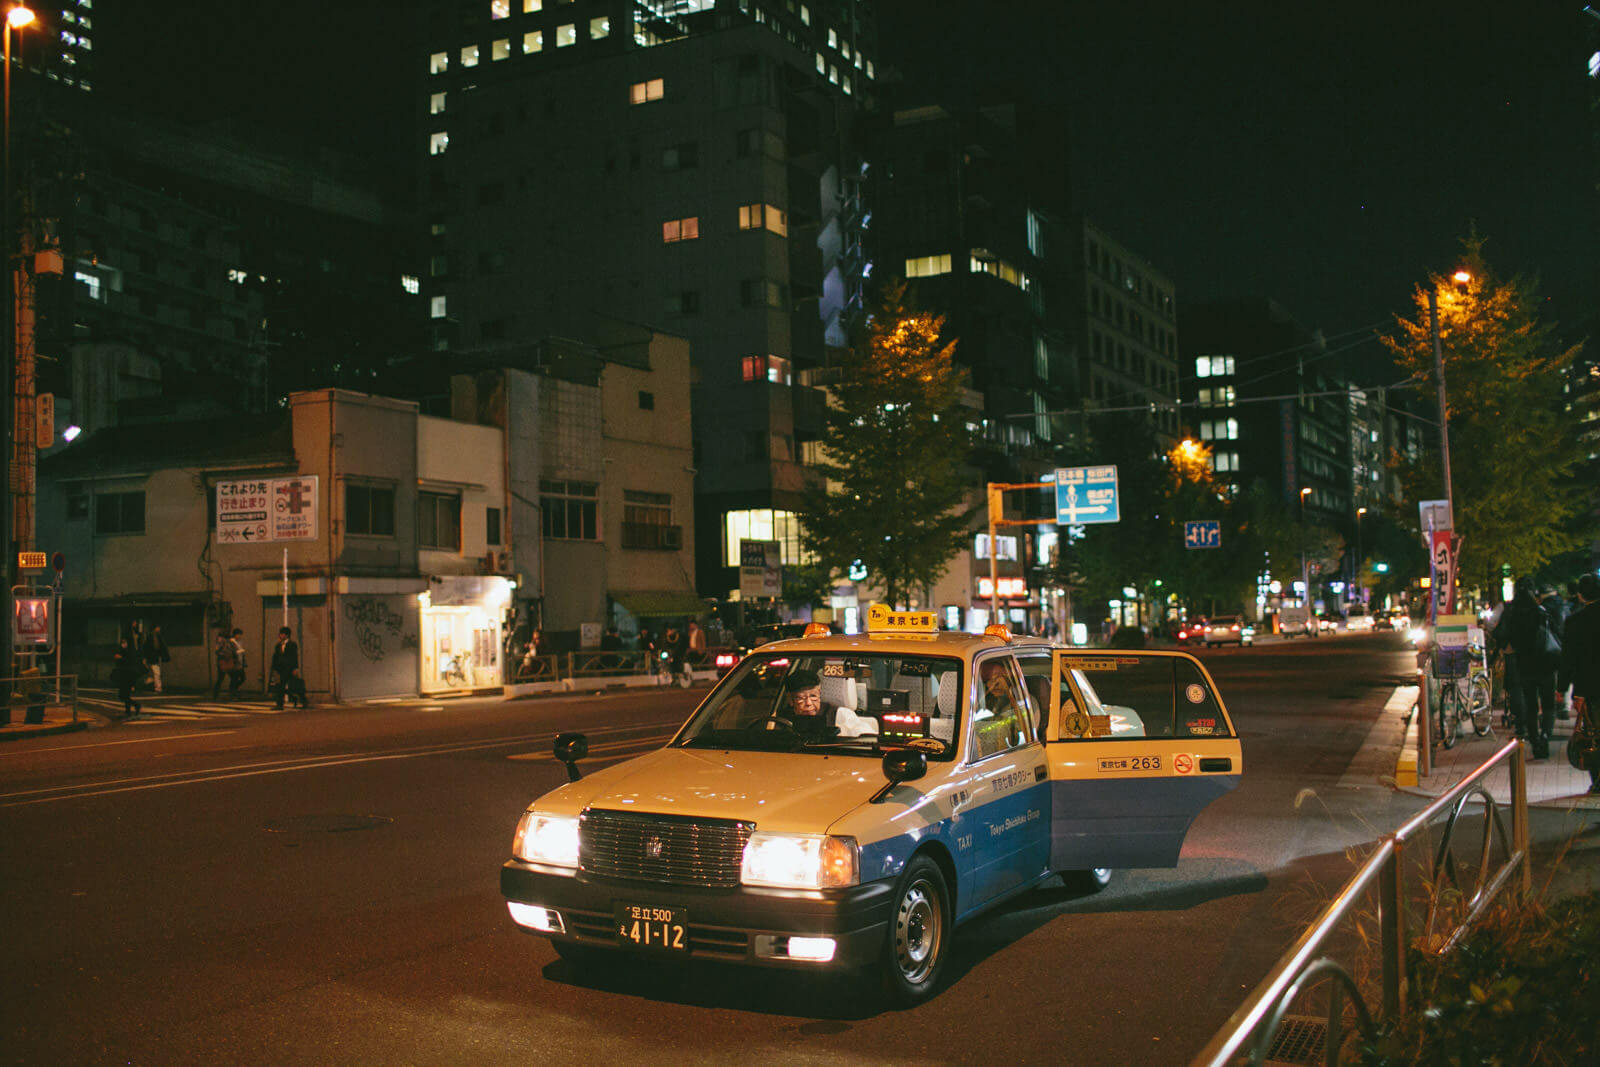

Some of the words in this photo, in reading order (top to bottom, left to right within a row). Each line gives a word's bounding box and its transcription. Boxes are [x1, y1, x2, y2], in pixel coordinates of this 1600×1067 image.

[221, 482, 267, 495] これより先
[220, 498, 266, 510] 行き止まり
[887, 616, 929, 626] 東京七福
[824, 665, 844, 676] 263
[1101, 760, 1128, 769] 東京七福
[1131, 757, 1161, 770] 263
[992, 769, 1032, 793] 東京七福タクシー
[957, 833, 972, 851] TAXI
[630, 920, 684, 949] 41-12
